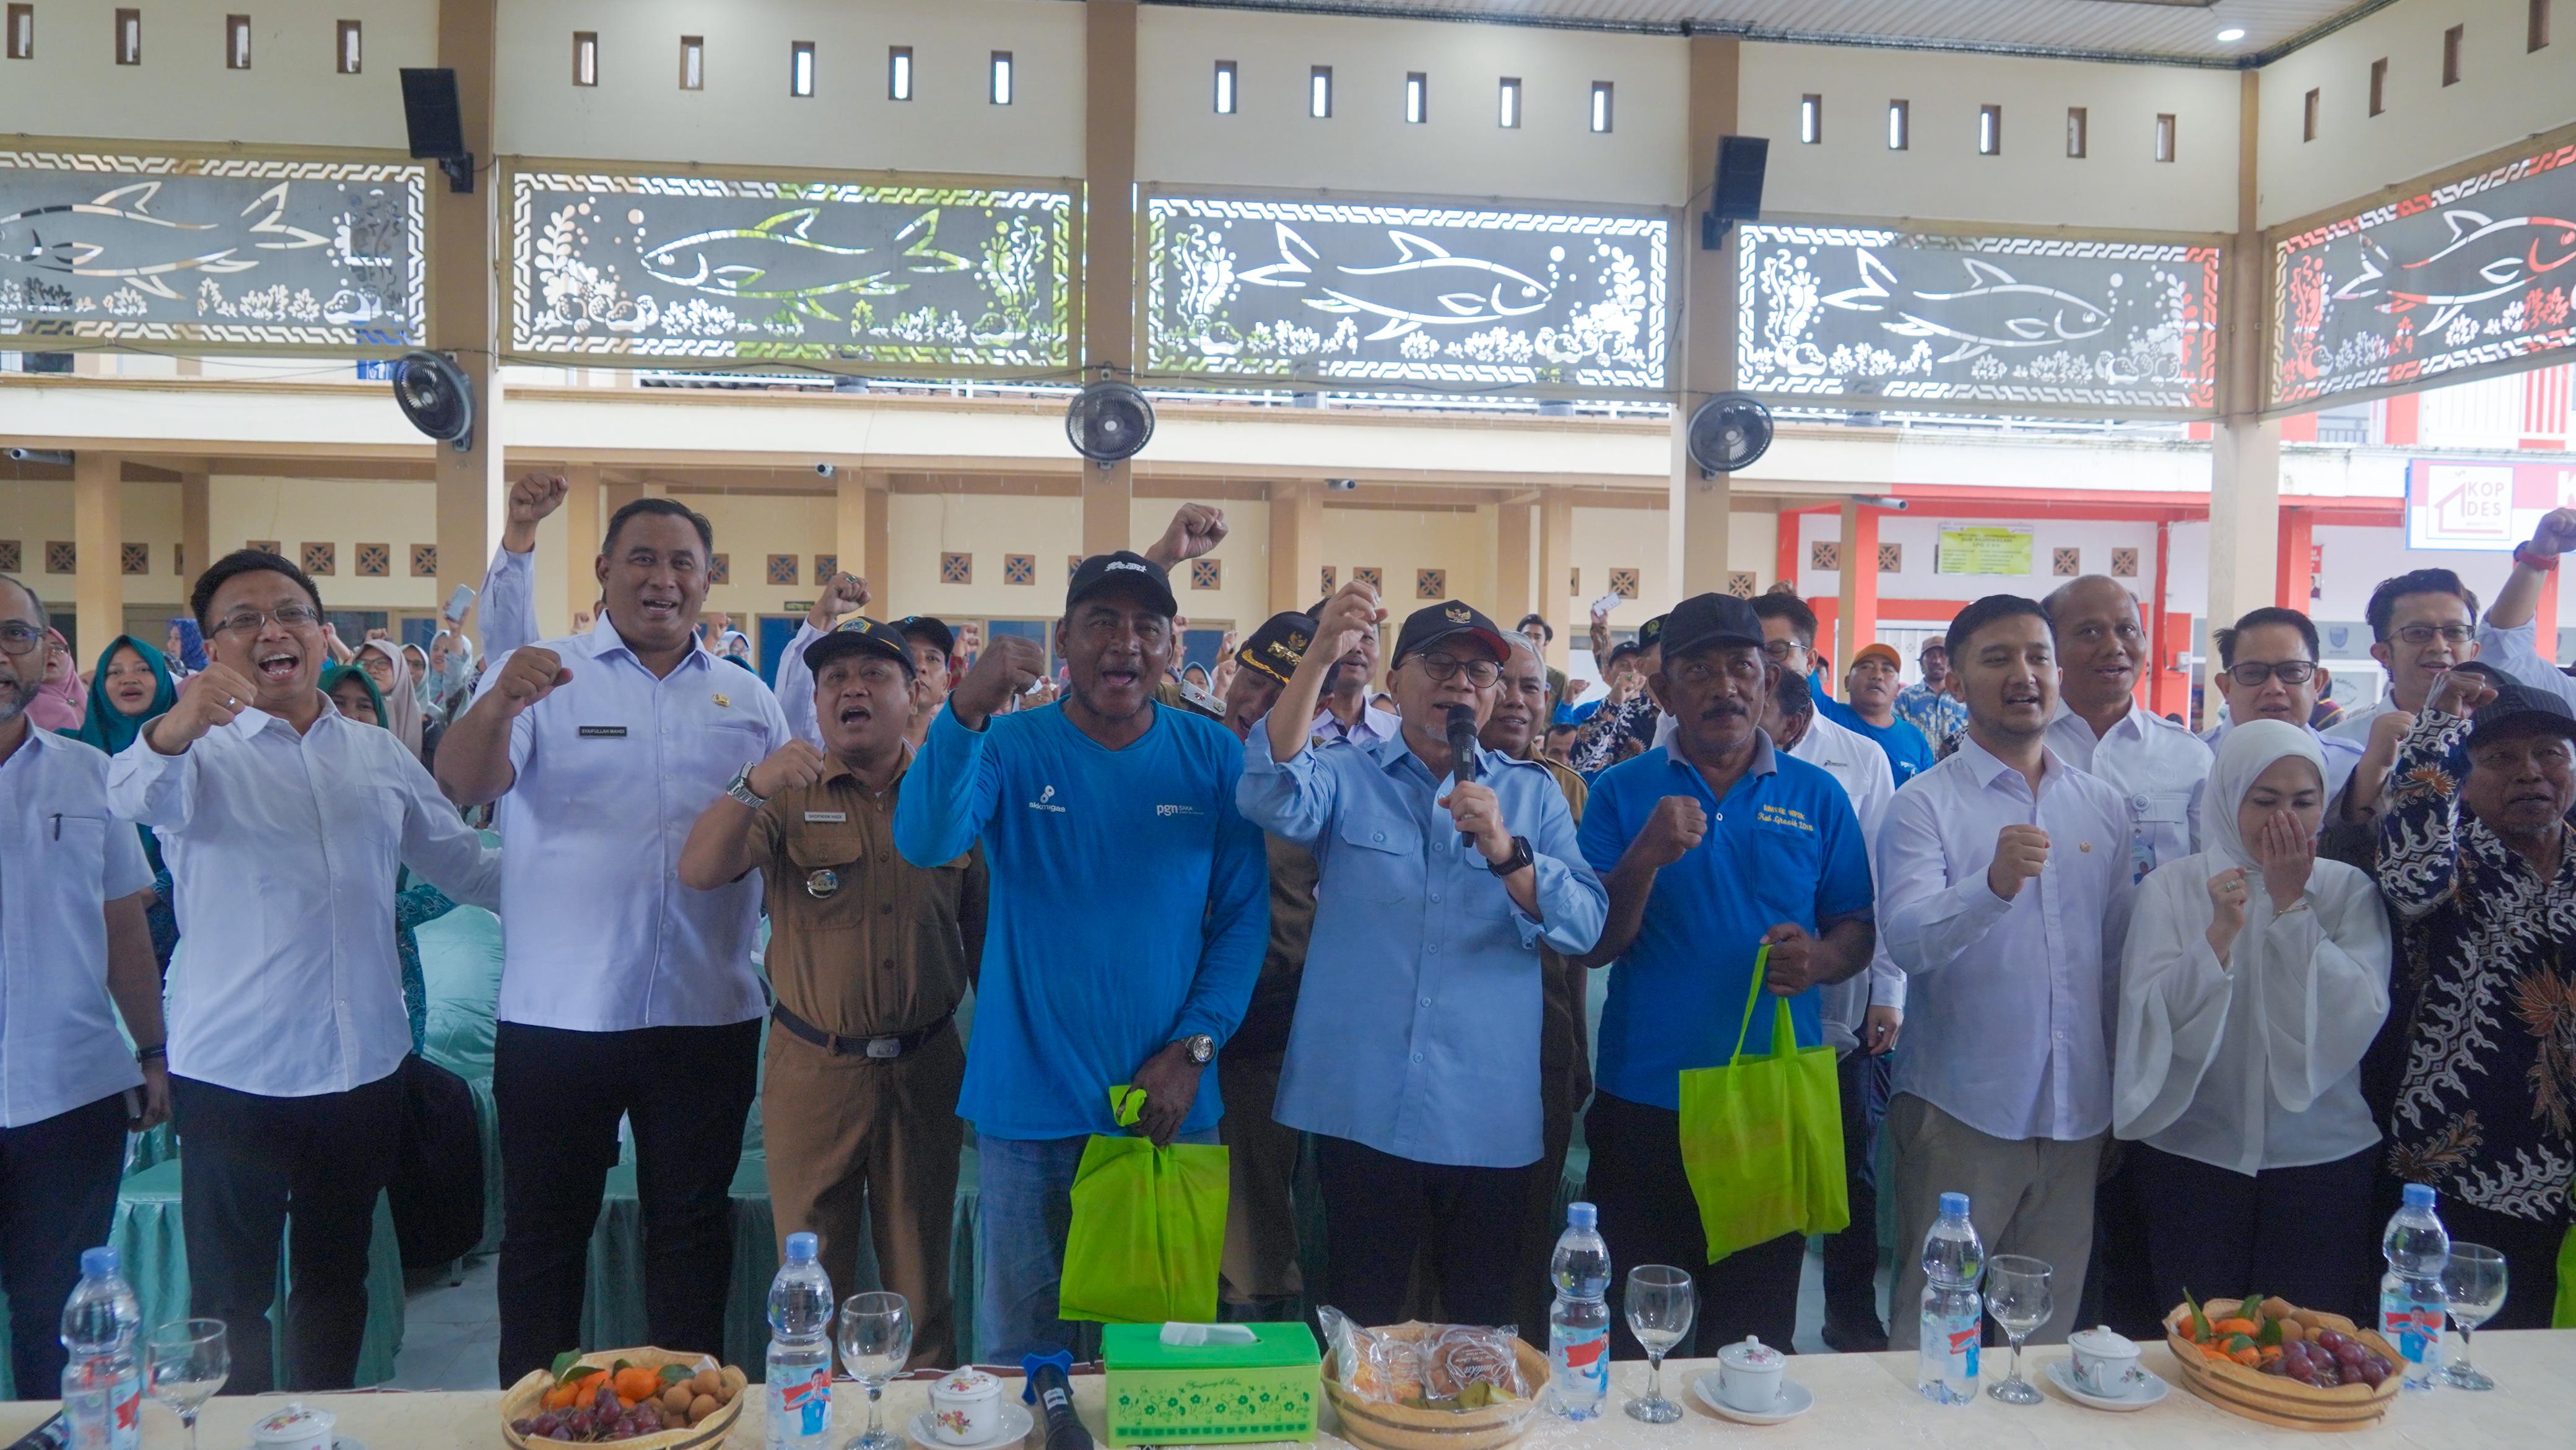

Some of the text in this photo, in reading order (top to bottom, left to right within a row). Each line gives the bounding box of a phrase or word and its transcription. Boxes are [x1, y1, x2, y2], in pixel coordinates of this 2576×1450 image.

[2468, 481, 2505, 497] KOP
[2467, 501, 2502, 516] DES
[1029, 802, 1066, 812] skkmigas
[1156, 804, 1178, 816] pgn
